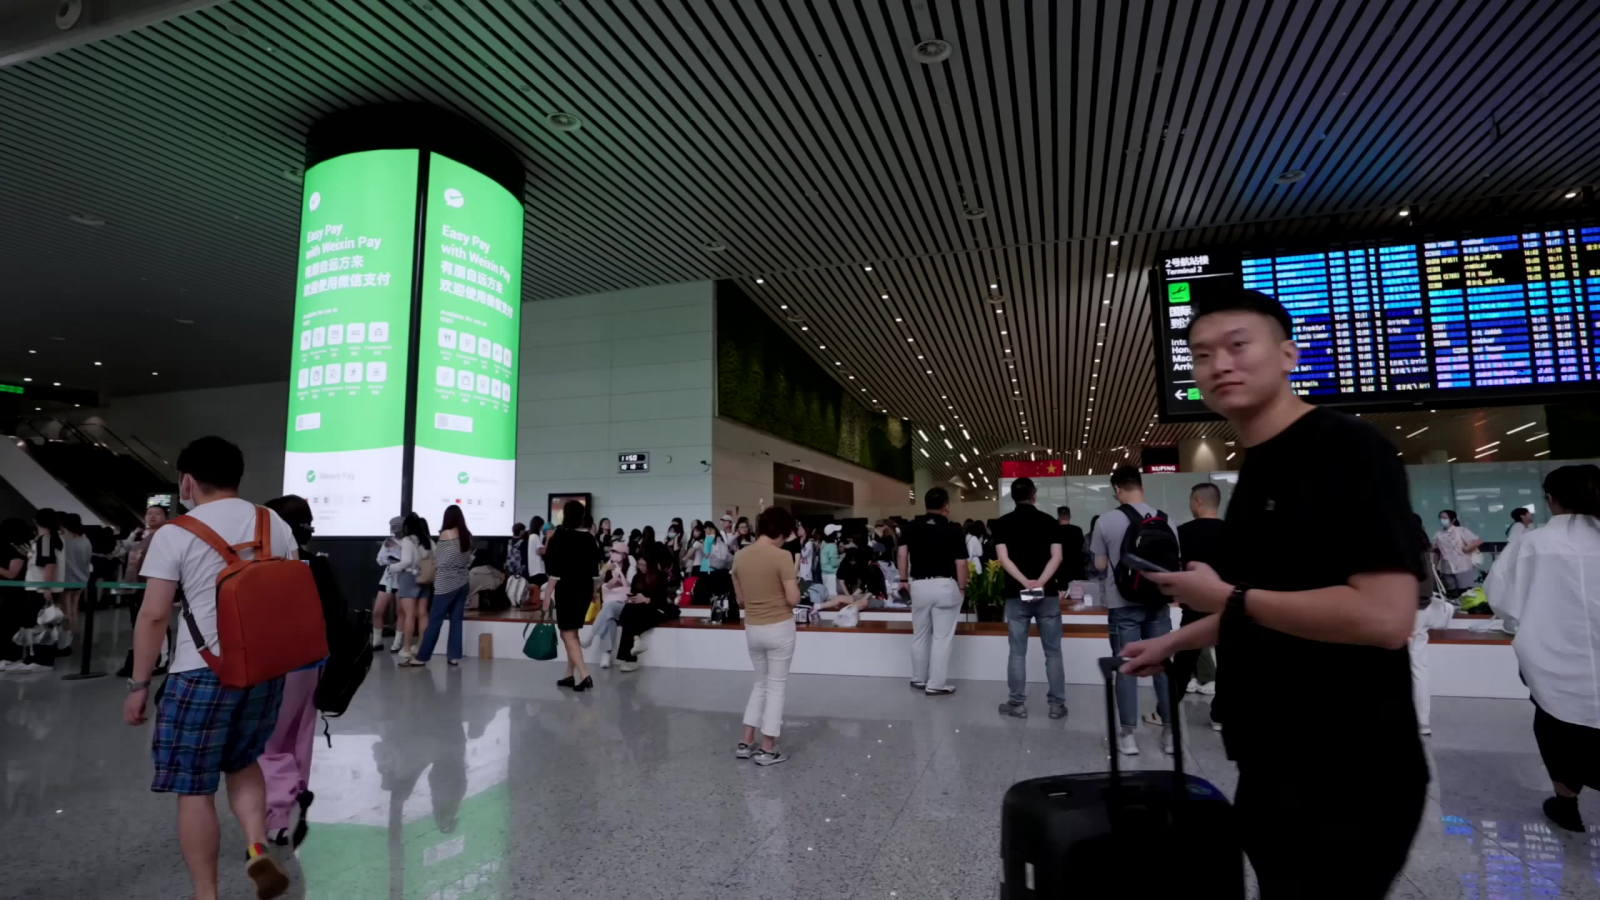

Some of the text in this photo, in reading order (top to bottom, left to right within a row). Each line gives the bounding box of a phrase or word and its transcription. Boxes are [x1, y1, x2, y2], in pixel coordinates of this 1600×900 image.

[325, 224, 343, 236] Pay
[322, 237, 355, 253] Weixin
[358, 236, 382, 250] Pay
[442, 225, 490, 254] Easy Pay
[442, 244, 510, 284] with Weixin Pay
[1166, 266, 1196, 275] Terminal
